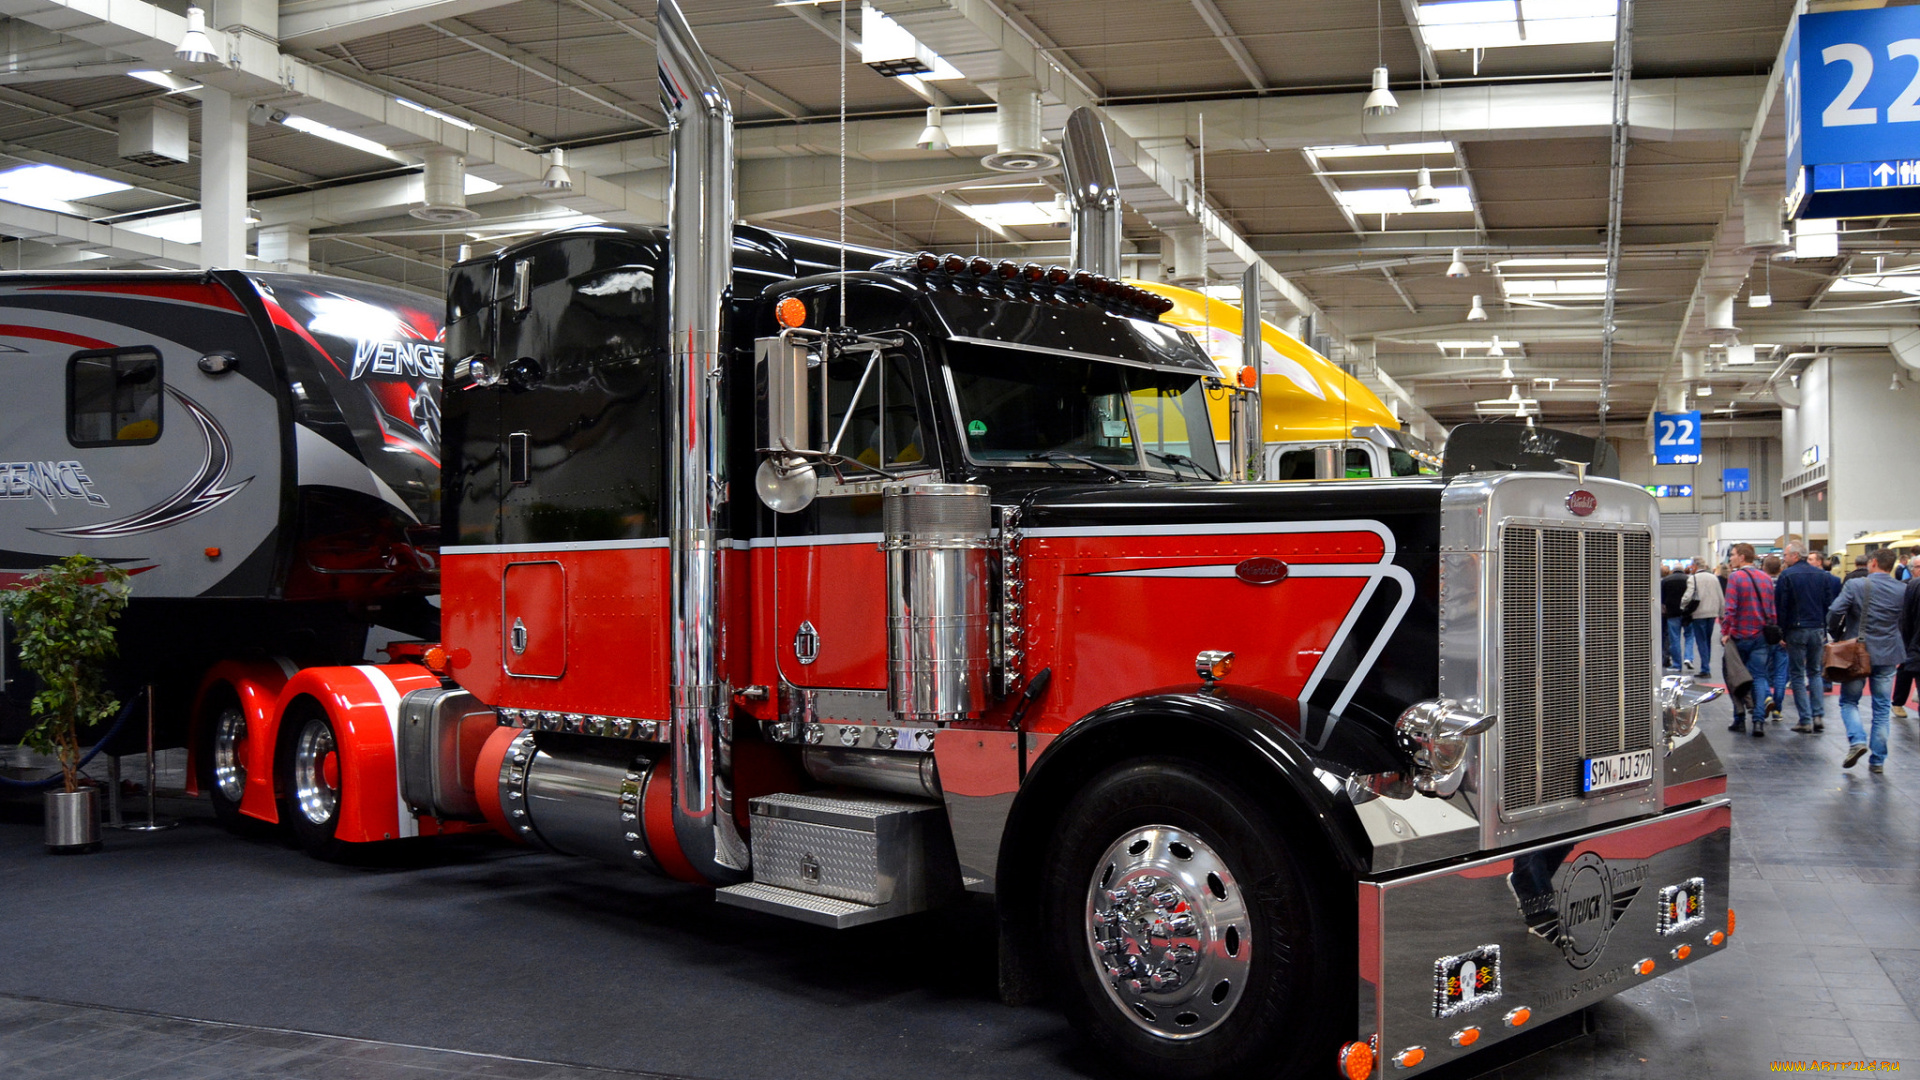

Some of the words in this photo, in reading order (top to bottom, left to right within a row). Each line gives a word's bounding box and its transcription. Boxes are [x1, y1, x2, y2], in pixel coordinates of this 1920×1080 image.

[1822, 38, 1920, 127] 22
[1659, 419, 1695, 446] 22
[1591, 759, 1612, 787] SPN
[1619, 755, 1632, 781] DJ
[1633, 752, 1651, 777] 379
[1569, 893, 1602, 927] TRUCK
